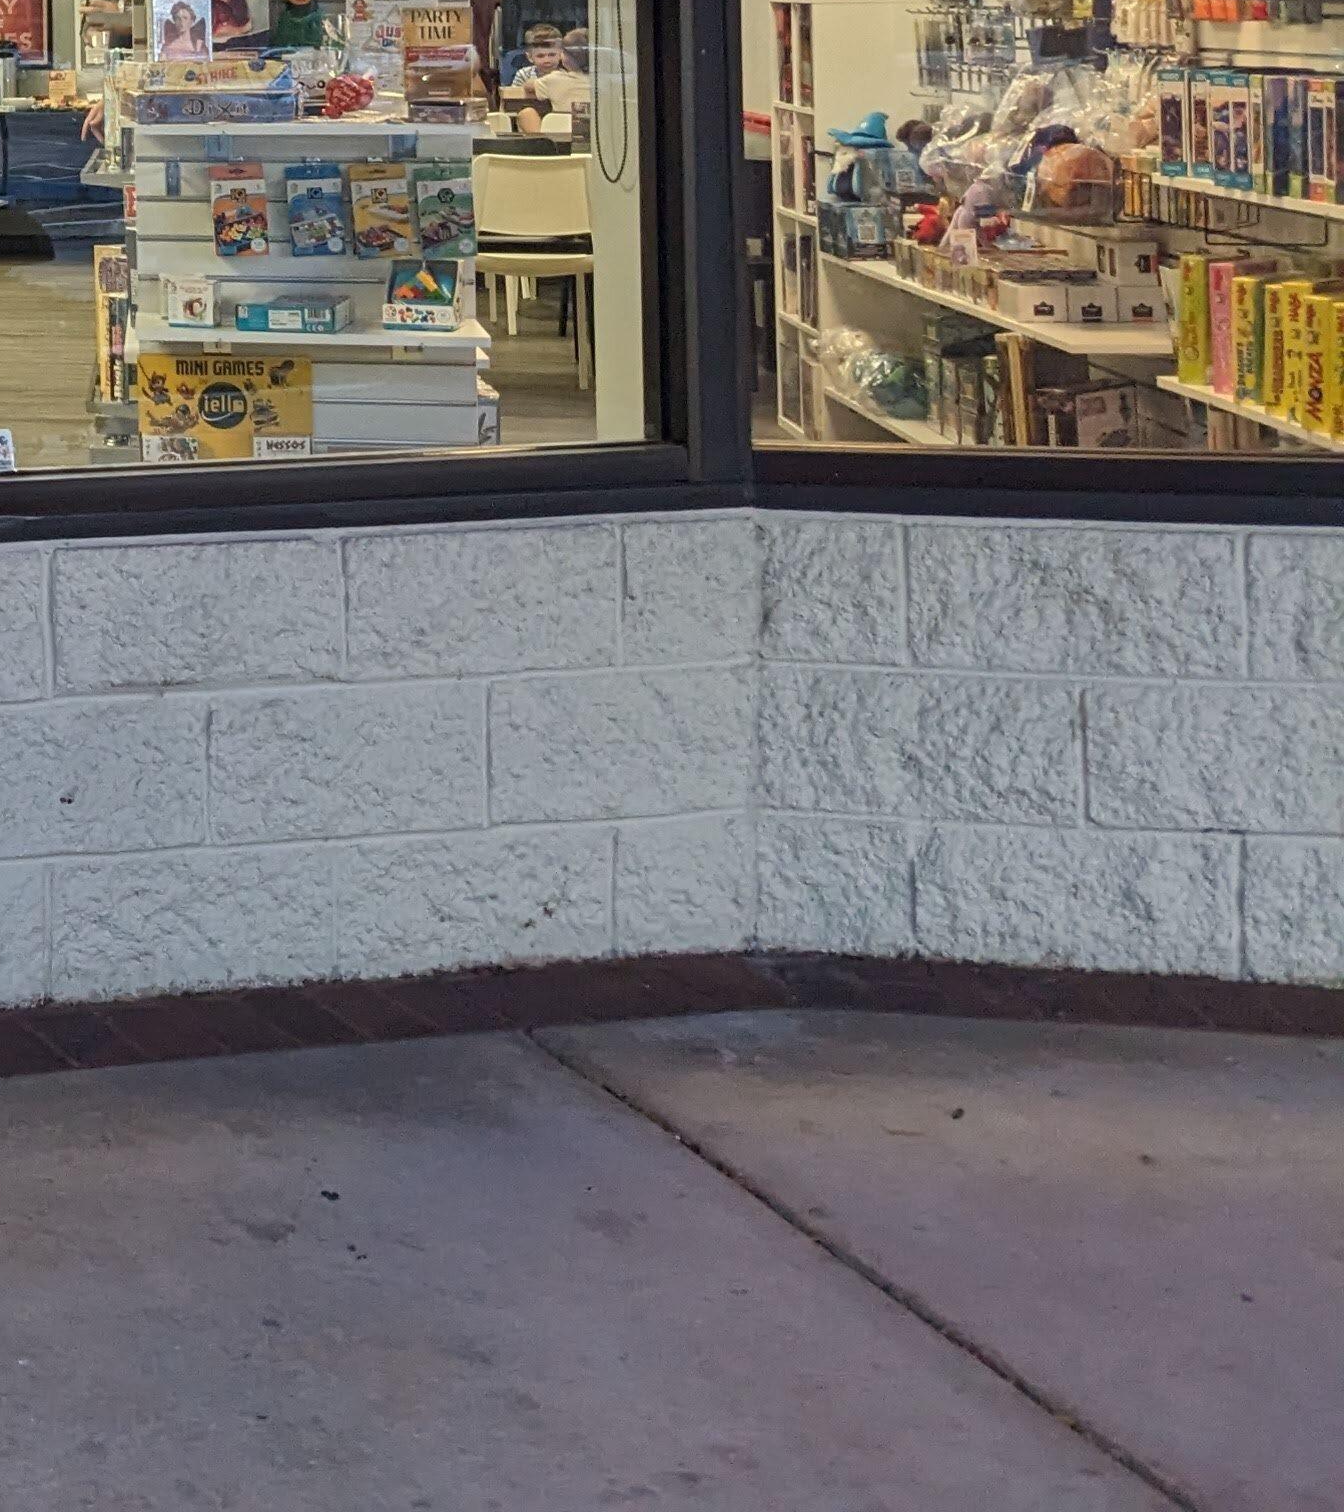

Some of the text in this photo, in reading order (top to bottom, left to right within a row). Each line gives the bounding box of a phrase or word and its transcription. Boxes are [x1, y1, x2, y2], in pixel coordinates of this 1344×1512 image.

[410, 9, 462, 23] PARTY
[375, 24, 402, 39] JUS
[419, 25, 456, 40] TIME
[175, 359, 265, 376] MINI GAMES
[1305, 351, 1324, 423] MONZA
